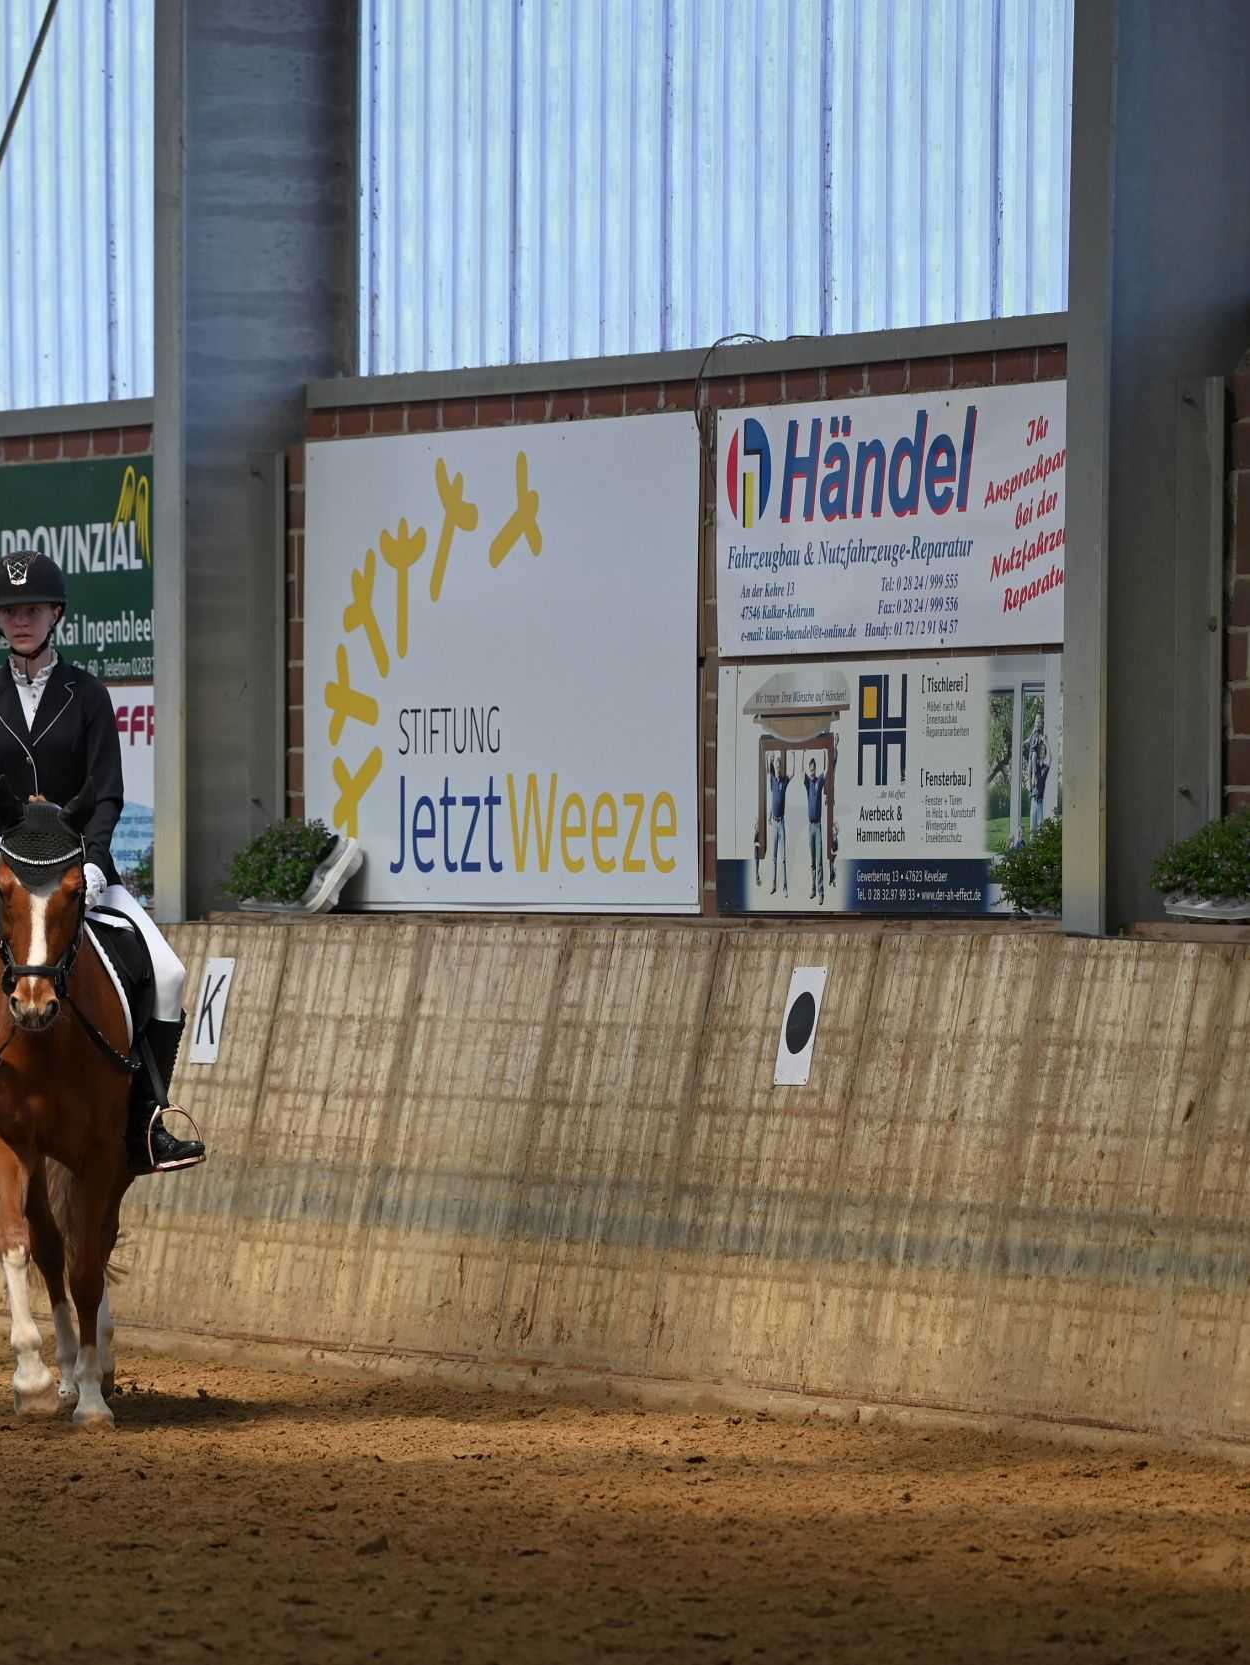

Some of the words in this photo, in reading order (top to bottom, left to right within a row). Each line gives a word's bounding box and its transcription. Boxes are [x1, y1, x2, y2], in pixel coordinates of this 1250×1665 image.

[1027, 415, 1049, 447] Ihr
[780, 405, 977, 523] Händel
[1014, 498, 1033, 531] bei
[1036, 490, 1059, 520] der
[727, 542, 800, 574] Fahrzeugbau
[804, 541, 815, 566] &
[818, 535, 974, 570] Nutzfahrzeuge-Reparatur
[787, 581, 795, 597] 13
[881, 576, 895, 591] Tel:
[930, 574, 944, 590] 999
[878, 599, 895, 615] Fax:
[56, 613, 80, 645] Kai
[864, 622, 892, 639] Handy:
[398, 705, 501, 755] STIFTUNG
[859, 805, 894, 822] Averbeck
[896, 805, 903, 821] &
[856, 827, 905, 843] Hammerbach
[196, 974, 227, 1045] K
